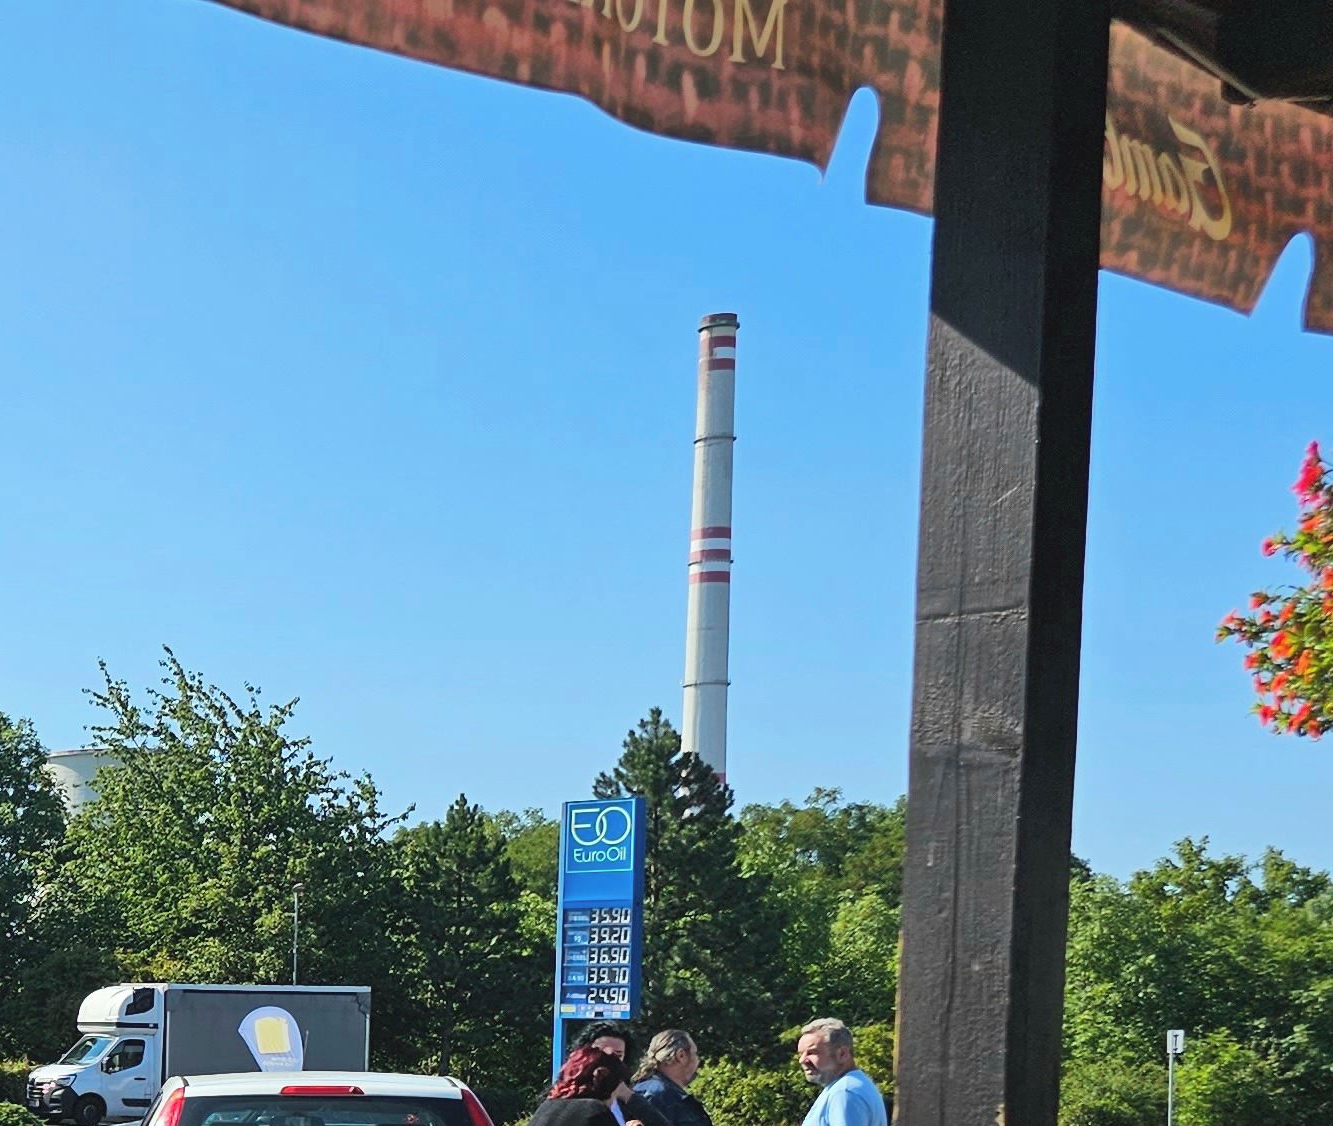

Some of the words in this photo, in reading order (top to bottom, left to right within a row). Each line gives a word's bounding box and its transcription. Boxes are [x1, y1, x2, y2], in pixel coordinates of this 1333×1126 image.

[573, 846, 626, 862] EuroOil
[590, 908, 631, 924] 35.90
[589, 926, 630, 945] 39.20
[589, 947, 630, 964] 36.90
[588, 967, 630, 984] 39.70
[587, 987, 629, 1004] 24.90
